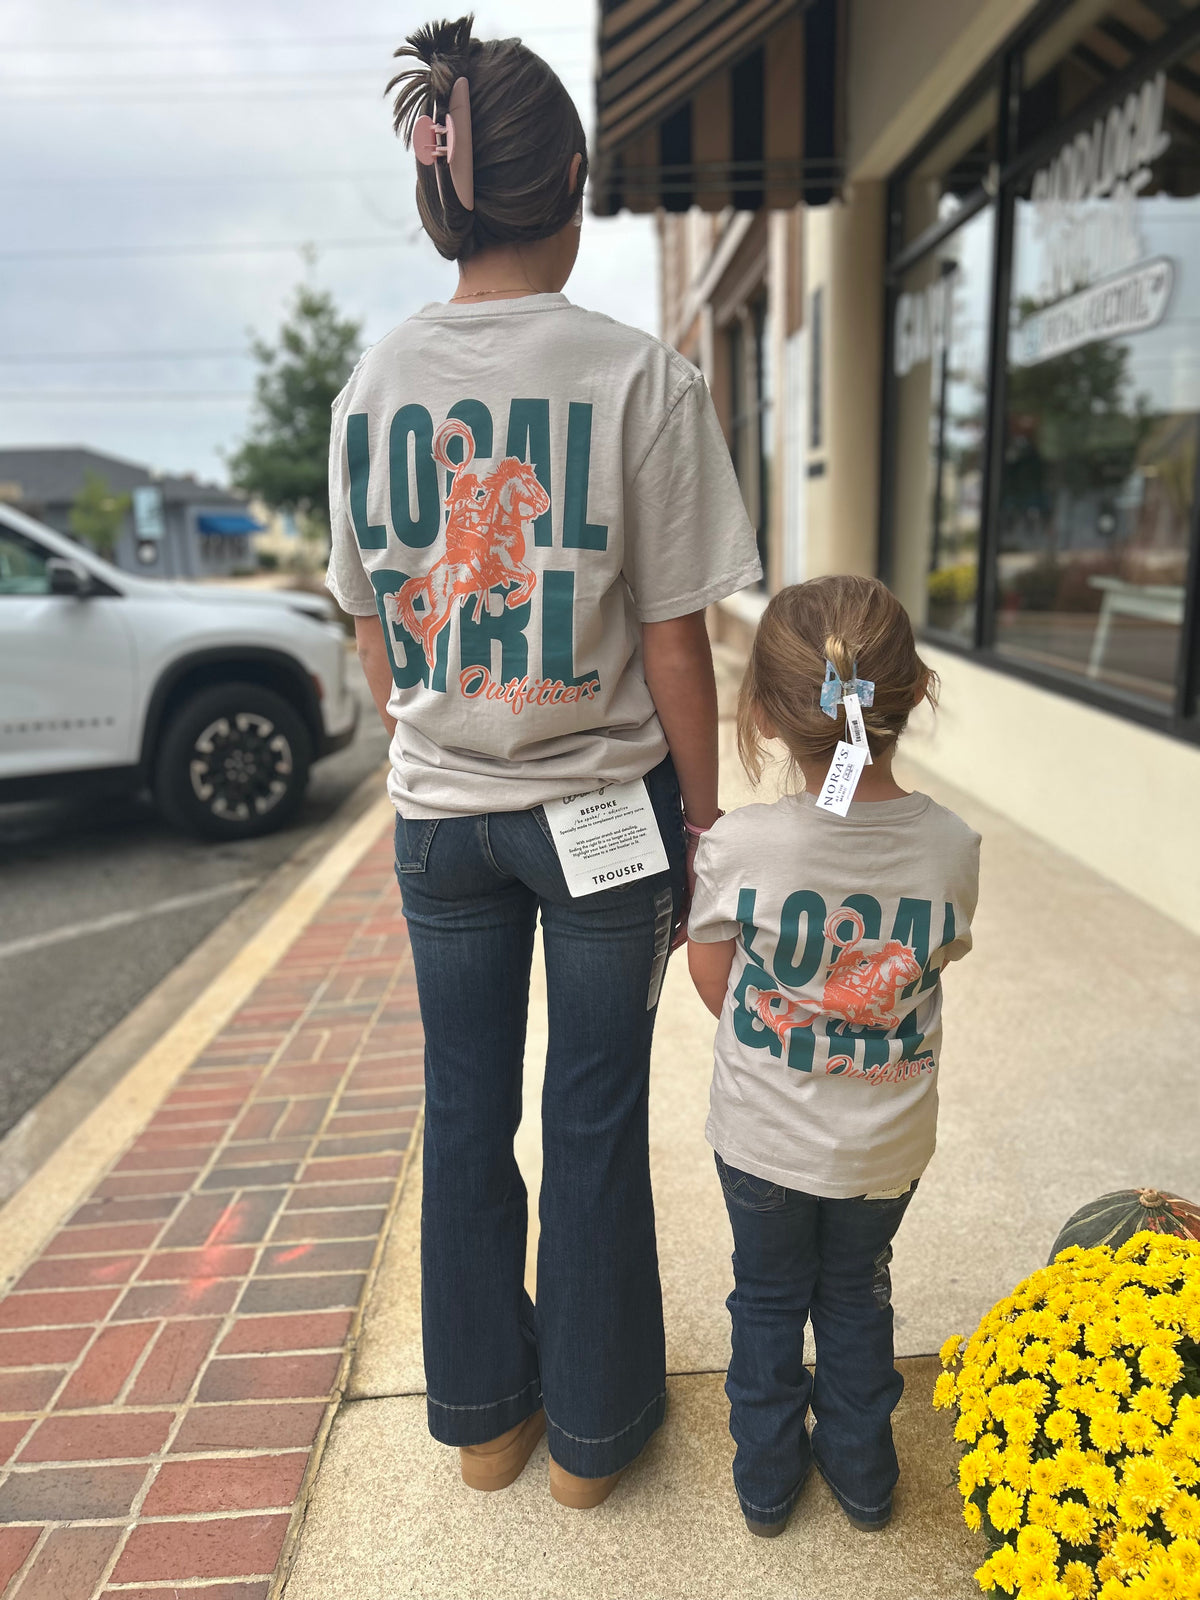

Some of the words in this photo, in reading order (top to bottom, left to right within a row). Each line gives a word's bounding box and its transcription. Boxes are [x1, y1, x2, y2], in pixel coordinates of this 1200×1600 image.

[347, 398, 608, 551] LOCAL
[459, 665, 600, 714] Outfitters
[824, 749, 849, 806] NORA'S
[580, 800, 617, 816] BESPOKE
[560, 827, 577, 835] Specially
[573, 850, 590, 858] Highlight
[583, 852, 601, 860] Welcome
[592, 862, 645, 885] TROUSER
[825, 1055, 934, 1086] Outfitters
